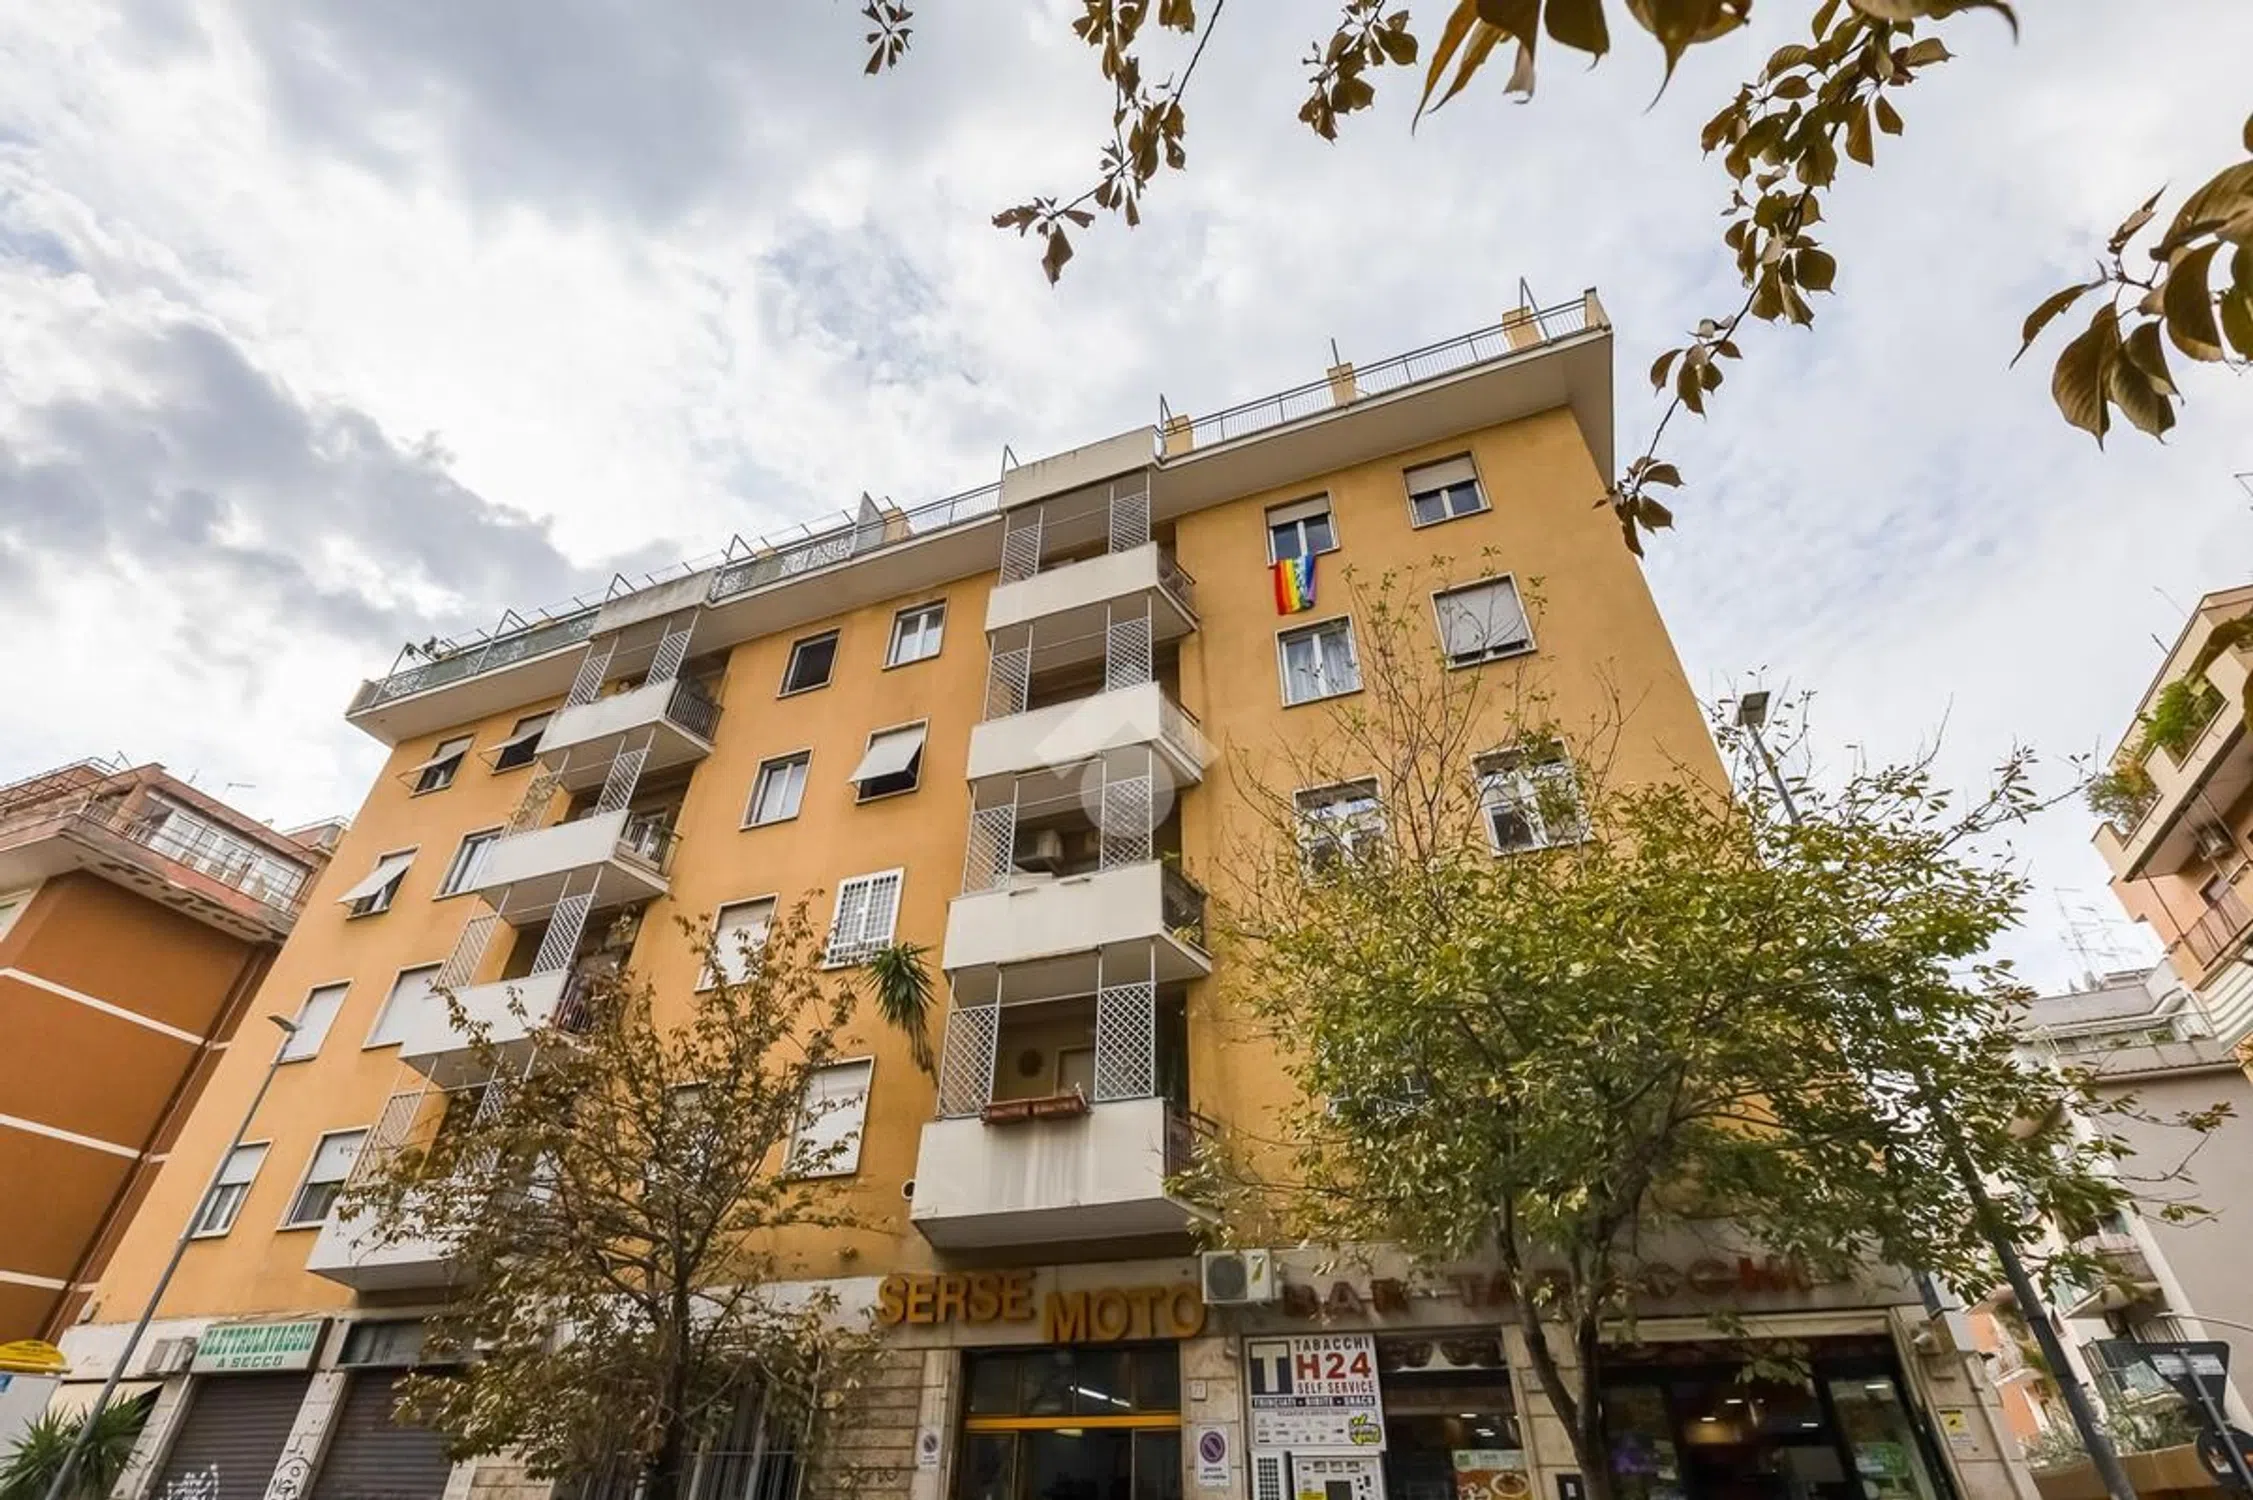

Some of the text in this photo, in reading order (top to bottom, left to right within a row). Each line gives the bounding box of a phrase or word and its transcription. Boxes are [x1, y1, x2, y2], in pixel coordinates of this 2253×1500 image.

[878, 1271, 1206, 1342] SERSE MOTO
[1294, 1337, 1370, 1351] TABACCHI
[215, 1355, 284, 1368] A SECCO
[1295, 1351, 1372, 1380] H24
[1298, 1380, 1375, 1394] SELF SERVICE
